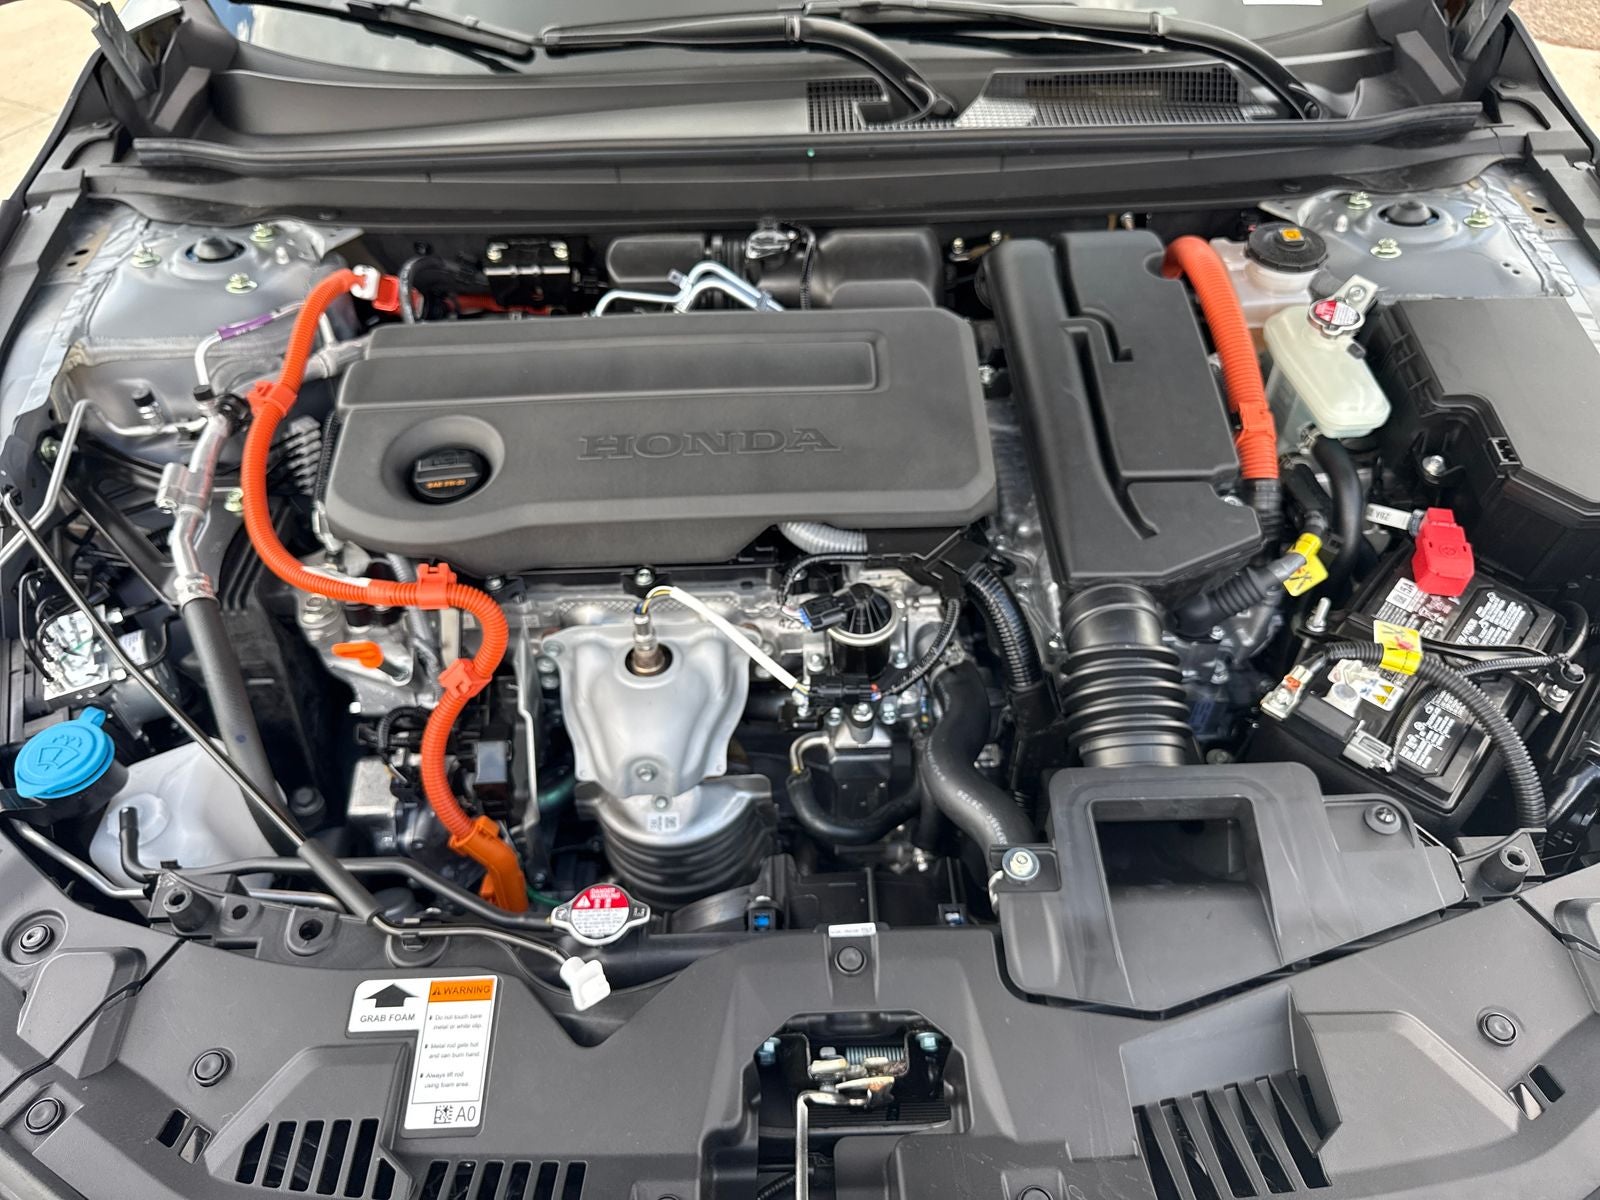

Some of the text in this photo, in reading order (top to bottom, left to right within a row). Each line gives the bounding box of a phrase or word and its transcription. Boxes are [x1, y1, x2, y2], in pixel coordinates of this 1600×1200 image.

[577, 428, 842, 461] HONDA
[443, 985, 491, 995] WARNING
[360, 1013, 415, 1023] GRAB FOAM
